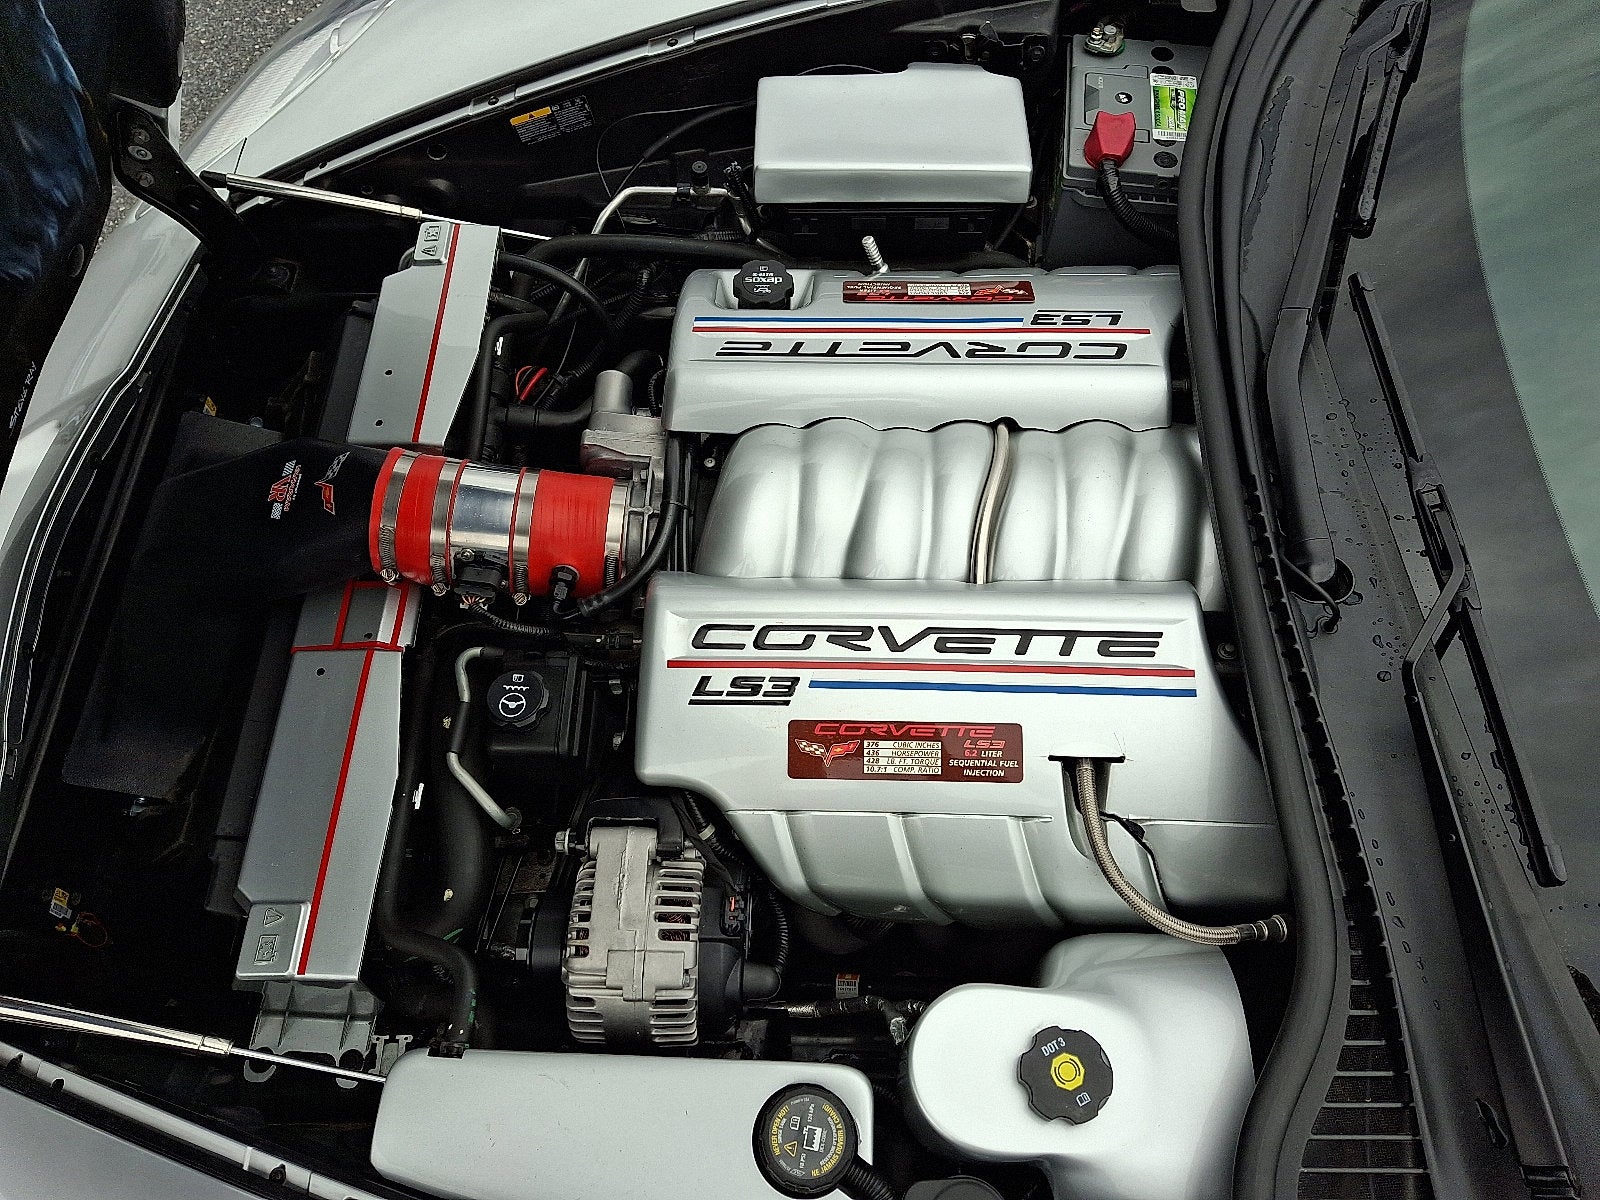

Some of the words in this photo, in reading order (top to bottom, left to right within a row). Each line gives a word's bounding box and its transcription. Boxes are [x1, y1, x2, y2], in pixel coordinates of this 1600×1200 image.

[744, 276, 783, 285] dexos
[1030, 313, 1122, 326] LS3
[715, 340, 1128, 360] CORVETTE
[691, 623, 1164, 658] CORVETTE
[691, 675, 801, 698] LS3
[814, 723, 996, 738] CORVETTE
[892, 741, 914, 749] CUBIC
[914, 741, 940, 749] INCHES
[963, 739, 1006, 749] LS3
[964, 749, 978, 757] 6.2
[981, 750, 1003, 758] LITER
[911, 758, 940, 766] TORQUE
[948, 759, 998, 767] SEQUENTIAL
[1000, 760, 1019, 768] FUEL
[893, 766, 916, 774] COMP.
[963, 769, 1005, 777] INJECTION
[1041, 1039, 1060, 1057] DOT
[1057, 1036, 1066, 1047] 3
[777, 1105, 790, 1119] HOT!
[821, 1103, 840, 1124] CHAUD!
[771, 1118, 782, 1135] OPEN
[771, 1135, 781, 1156] NEVER
[837, 1129, 845, 1155] OUVRIR
[820, 1154, 840, 1174] JAMAIS
[811, 1168, 820, 1177] NE
